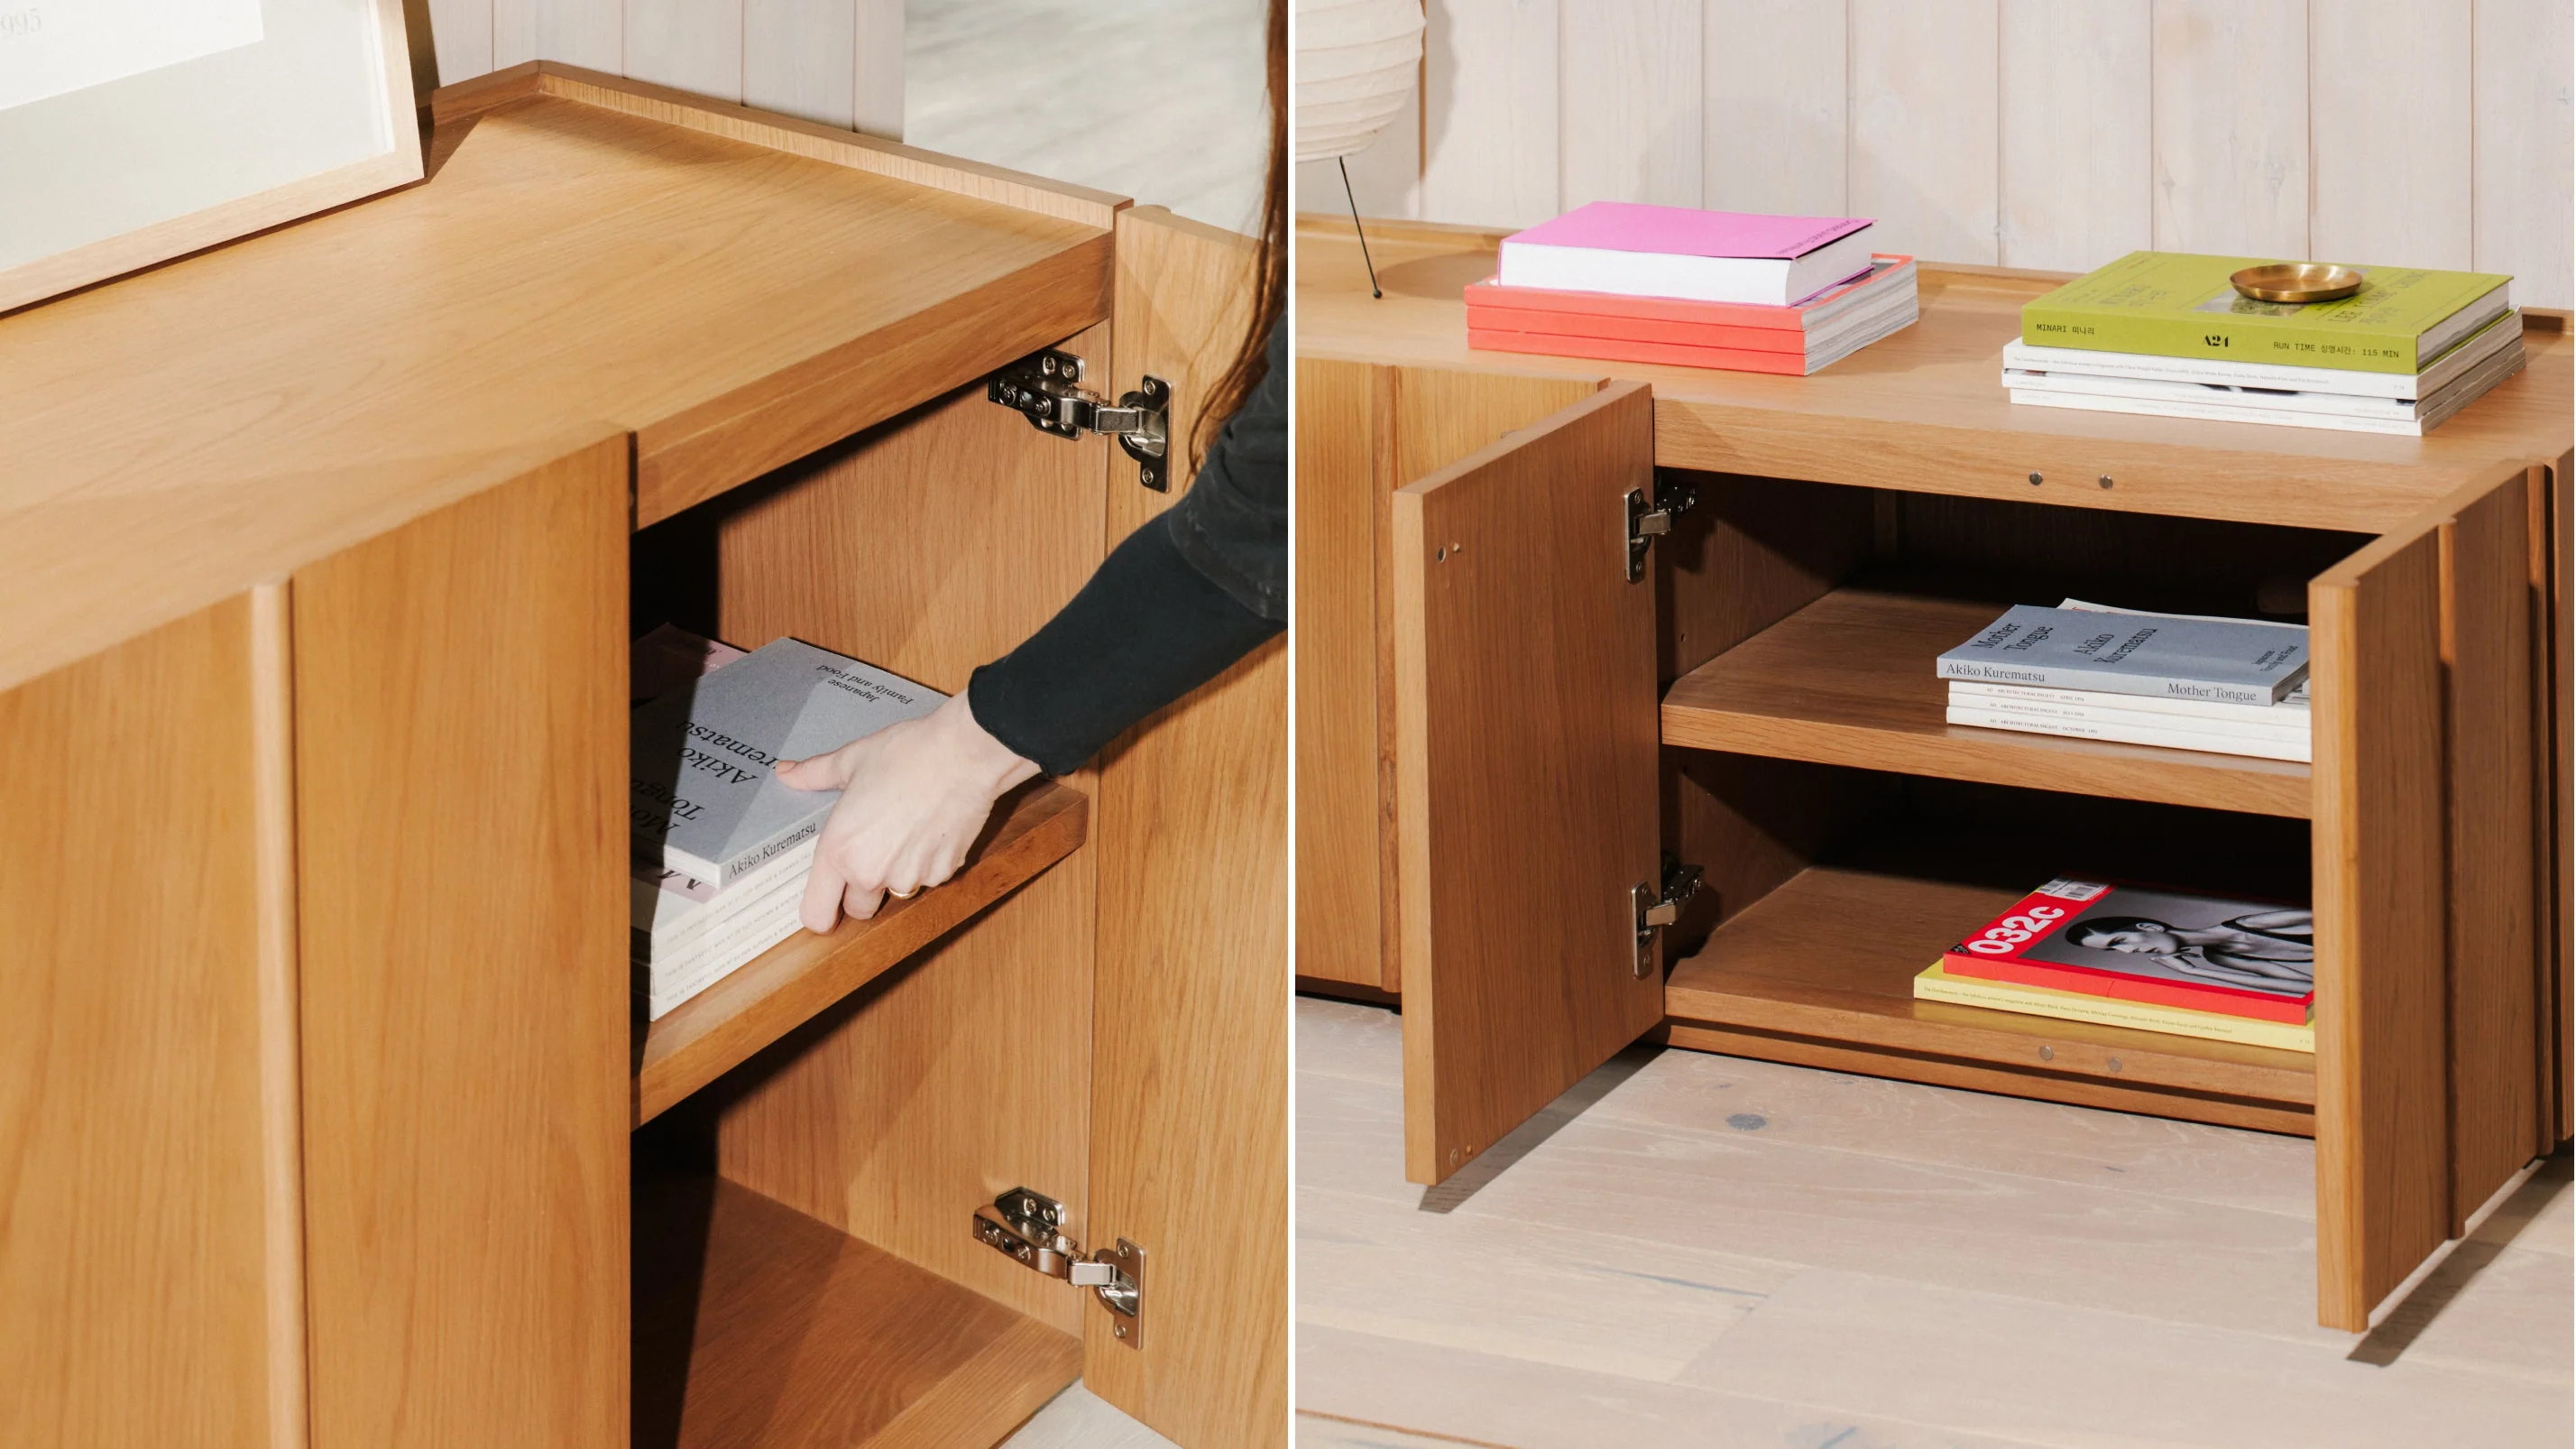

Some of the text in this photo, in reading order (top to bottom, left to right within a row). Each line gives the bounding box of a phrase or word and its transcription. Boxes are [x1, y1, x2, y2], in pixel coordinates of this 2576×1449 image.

[0, 8, 41, 40] 995
[2036, 323, 2095, 336] MINARI 미나리
[2203, 334, 2229, 347] A24
[2273, 341, 2290, 350] RUN
[2295, 343, 2315, 352] TIME
[2361, 348, 2378, 356] 115
[2382, 350, 2399, 358] MIN
[1971, 623, 2021, 649] Mother
[2003, 626, 2054, 651] Tongue
[2073, 633, 2115, 656] Akiko
[2093, 628, 2158, 664] Kurematsu
[815, 664, 915, 706] Family and Food
[1946, 663, 2046, 682] Akiko Kurematsu
[827, 678, 880, 703] Japanese
[2167, 683, 2257, 702] Mother Tongue
[676, 719, 777, 771] rematsu
[677, 747, 759, 785] Akiko
[729, 821, 817, 879] Akiko Kurematsu
[1967, 906, 2065, 955] 032c
